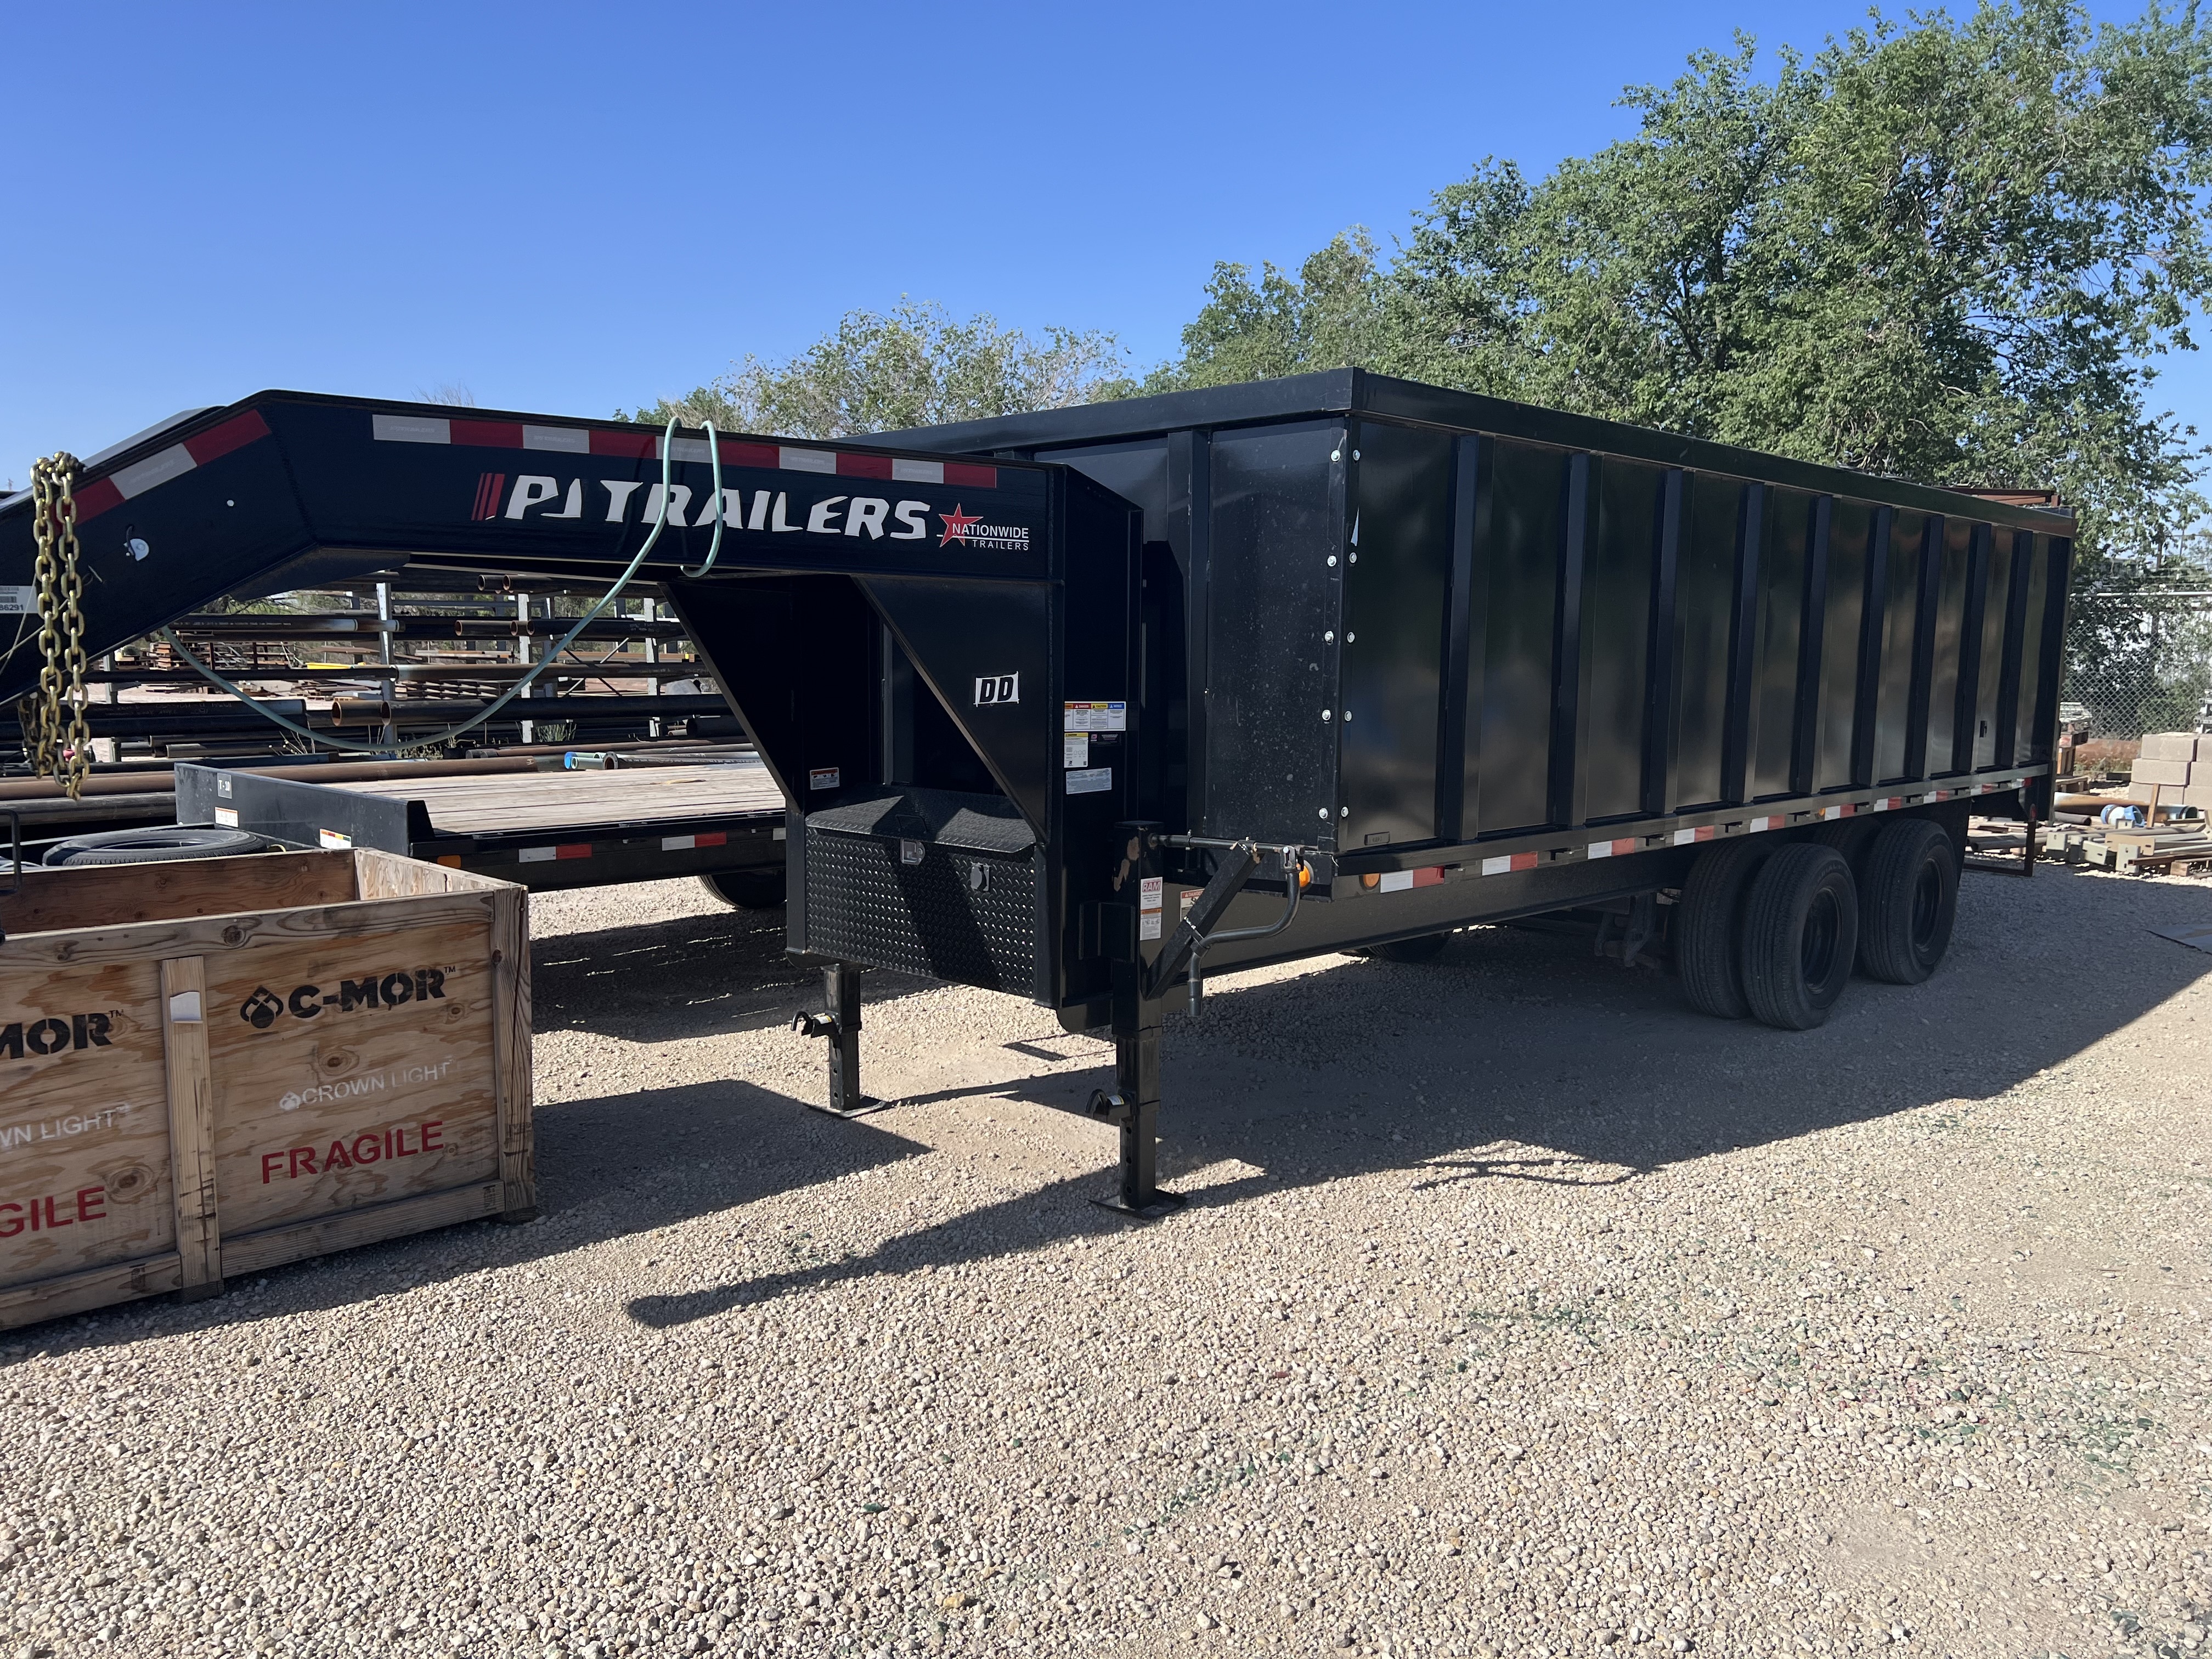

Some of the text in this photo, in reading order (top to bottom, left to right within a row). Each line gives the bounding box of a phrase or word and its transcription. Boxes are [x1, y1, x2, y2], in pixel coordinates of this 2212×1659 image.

[504, 475, 931, 540] PJ TRAILERS
[952, 523, 1029, 539] NATIONWIDE
[972, 539, 1029, 551] TRAILERS
[979, 676, 1014, 703] DD
[1142, 881, 1161, 893] RAM
[288, 968, 447, 1019] C-MOR
[302, 1061, 450, 1104] CROWN LIGHT
[41, 1109, 117, 1139] LIGHT
[262, 1120, 444, 1184] FRAGILE
[0, 1185, 106, 1238] GILE
